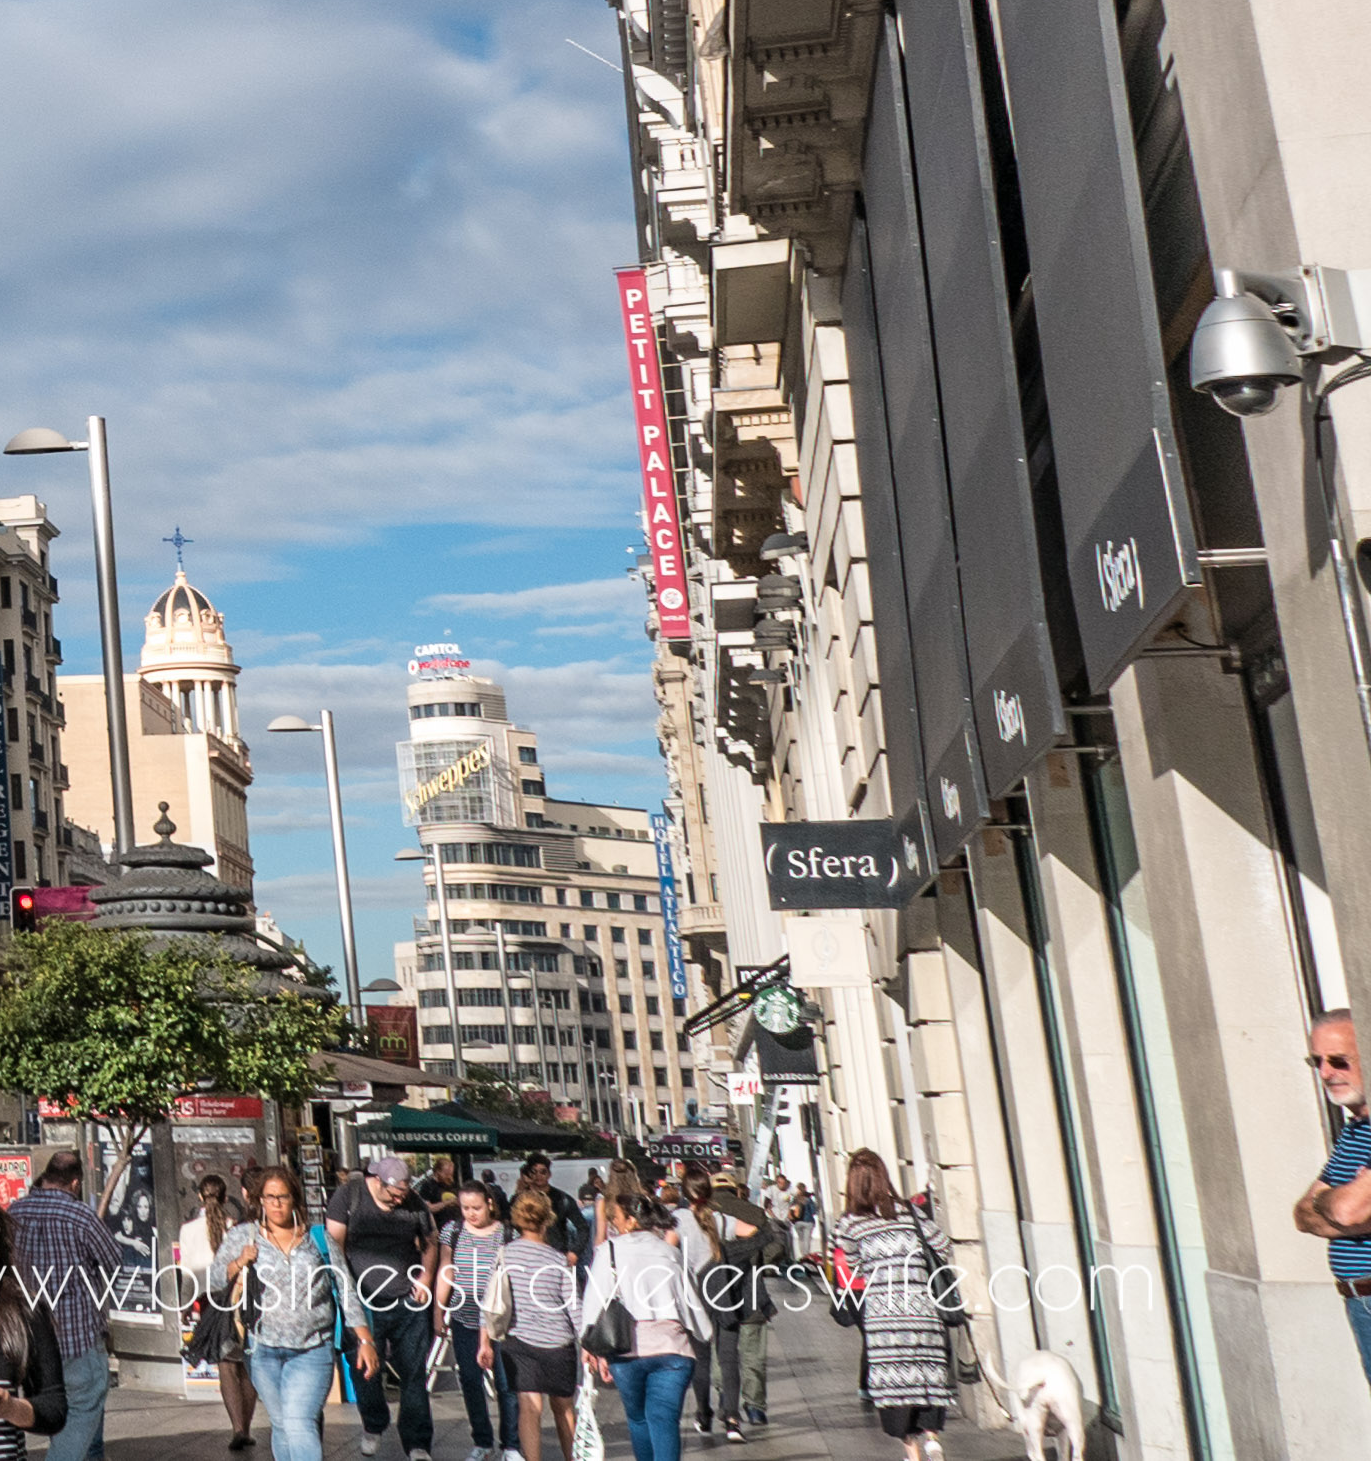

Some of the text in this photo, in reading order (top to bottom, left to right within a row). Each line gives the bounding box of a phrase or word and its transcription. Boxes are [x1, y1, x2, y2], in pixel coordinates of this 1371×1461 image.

[626, 288, 655, 410] PETIT
[643, 425, 677, 577] PALACE
[405, 743, 491, 817] Schweppes
[653, 817, 685, 996] HOTEL ATLANTICO
[446, 1133, 489, 1143] COFFEE
